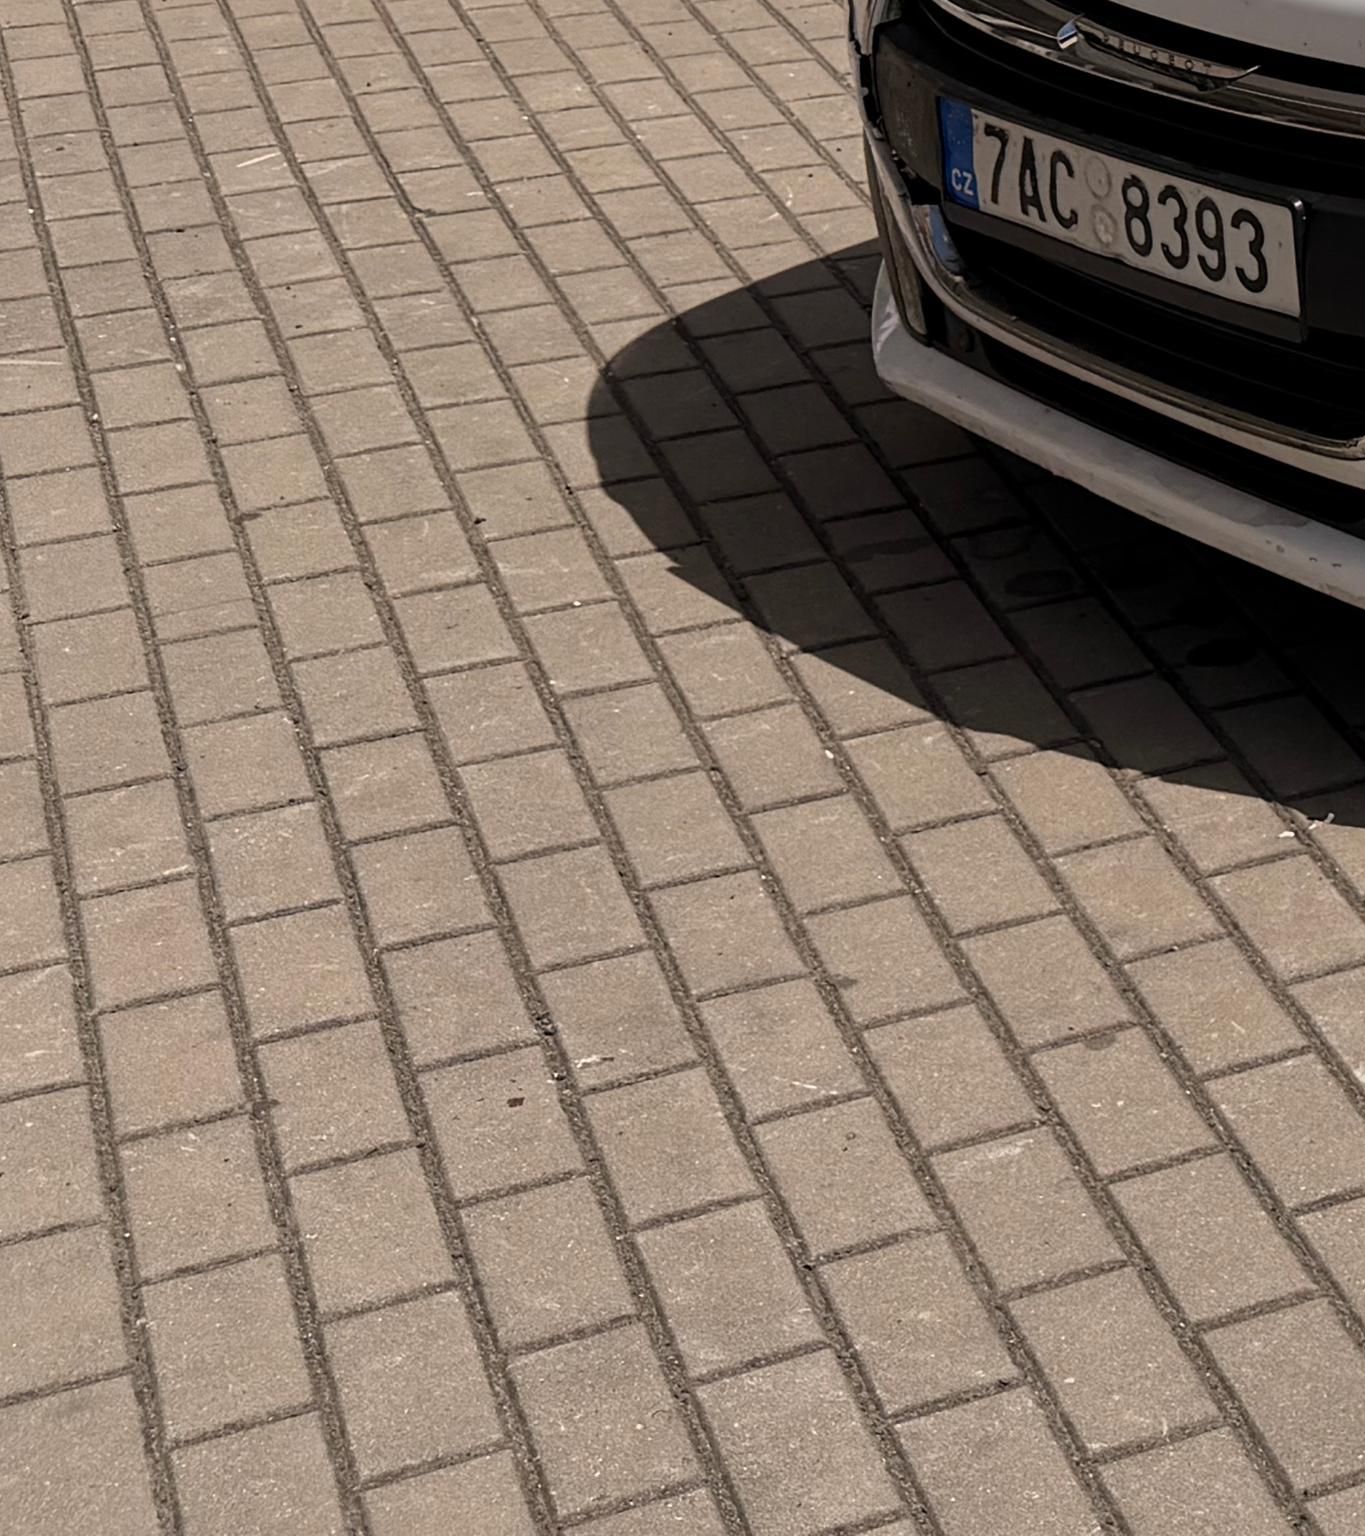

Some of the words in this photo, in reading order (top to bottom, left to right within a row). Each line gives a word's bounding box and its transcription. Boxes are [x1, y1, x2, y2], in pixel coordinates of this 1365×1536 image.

[952, 167, 975, 196] CZ
[984, 123, 1078, 230] 7AC
[1121, 174, 1268, 293] 8393
